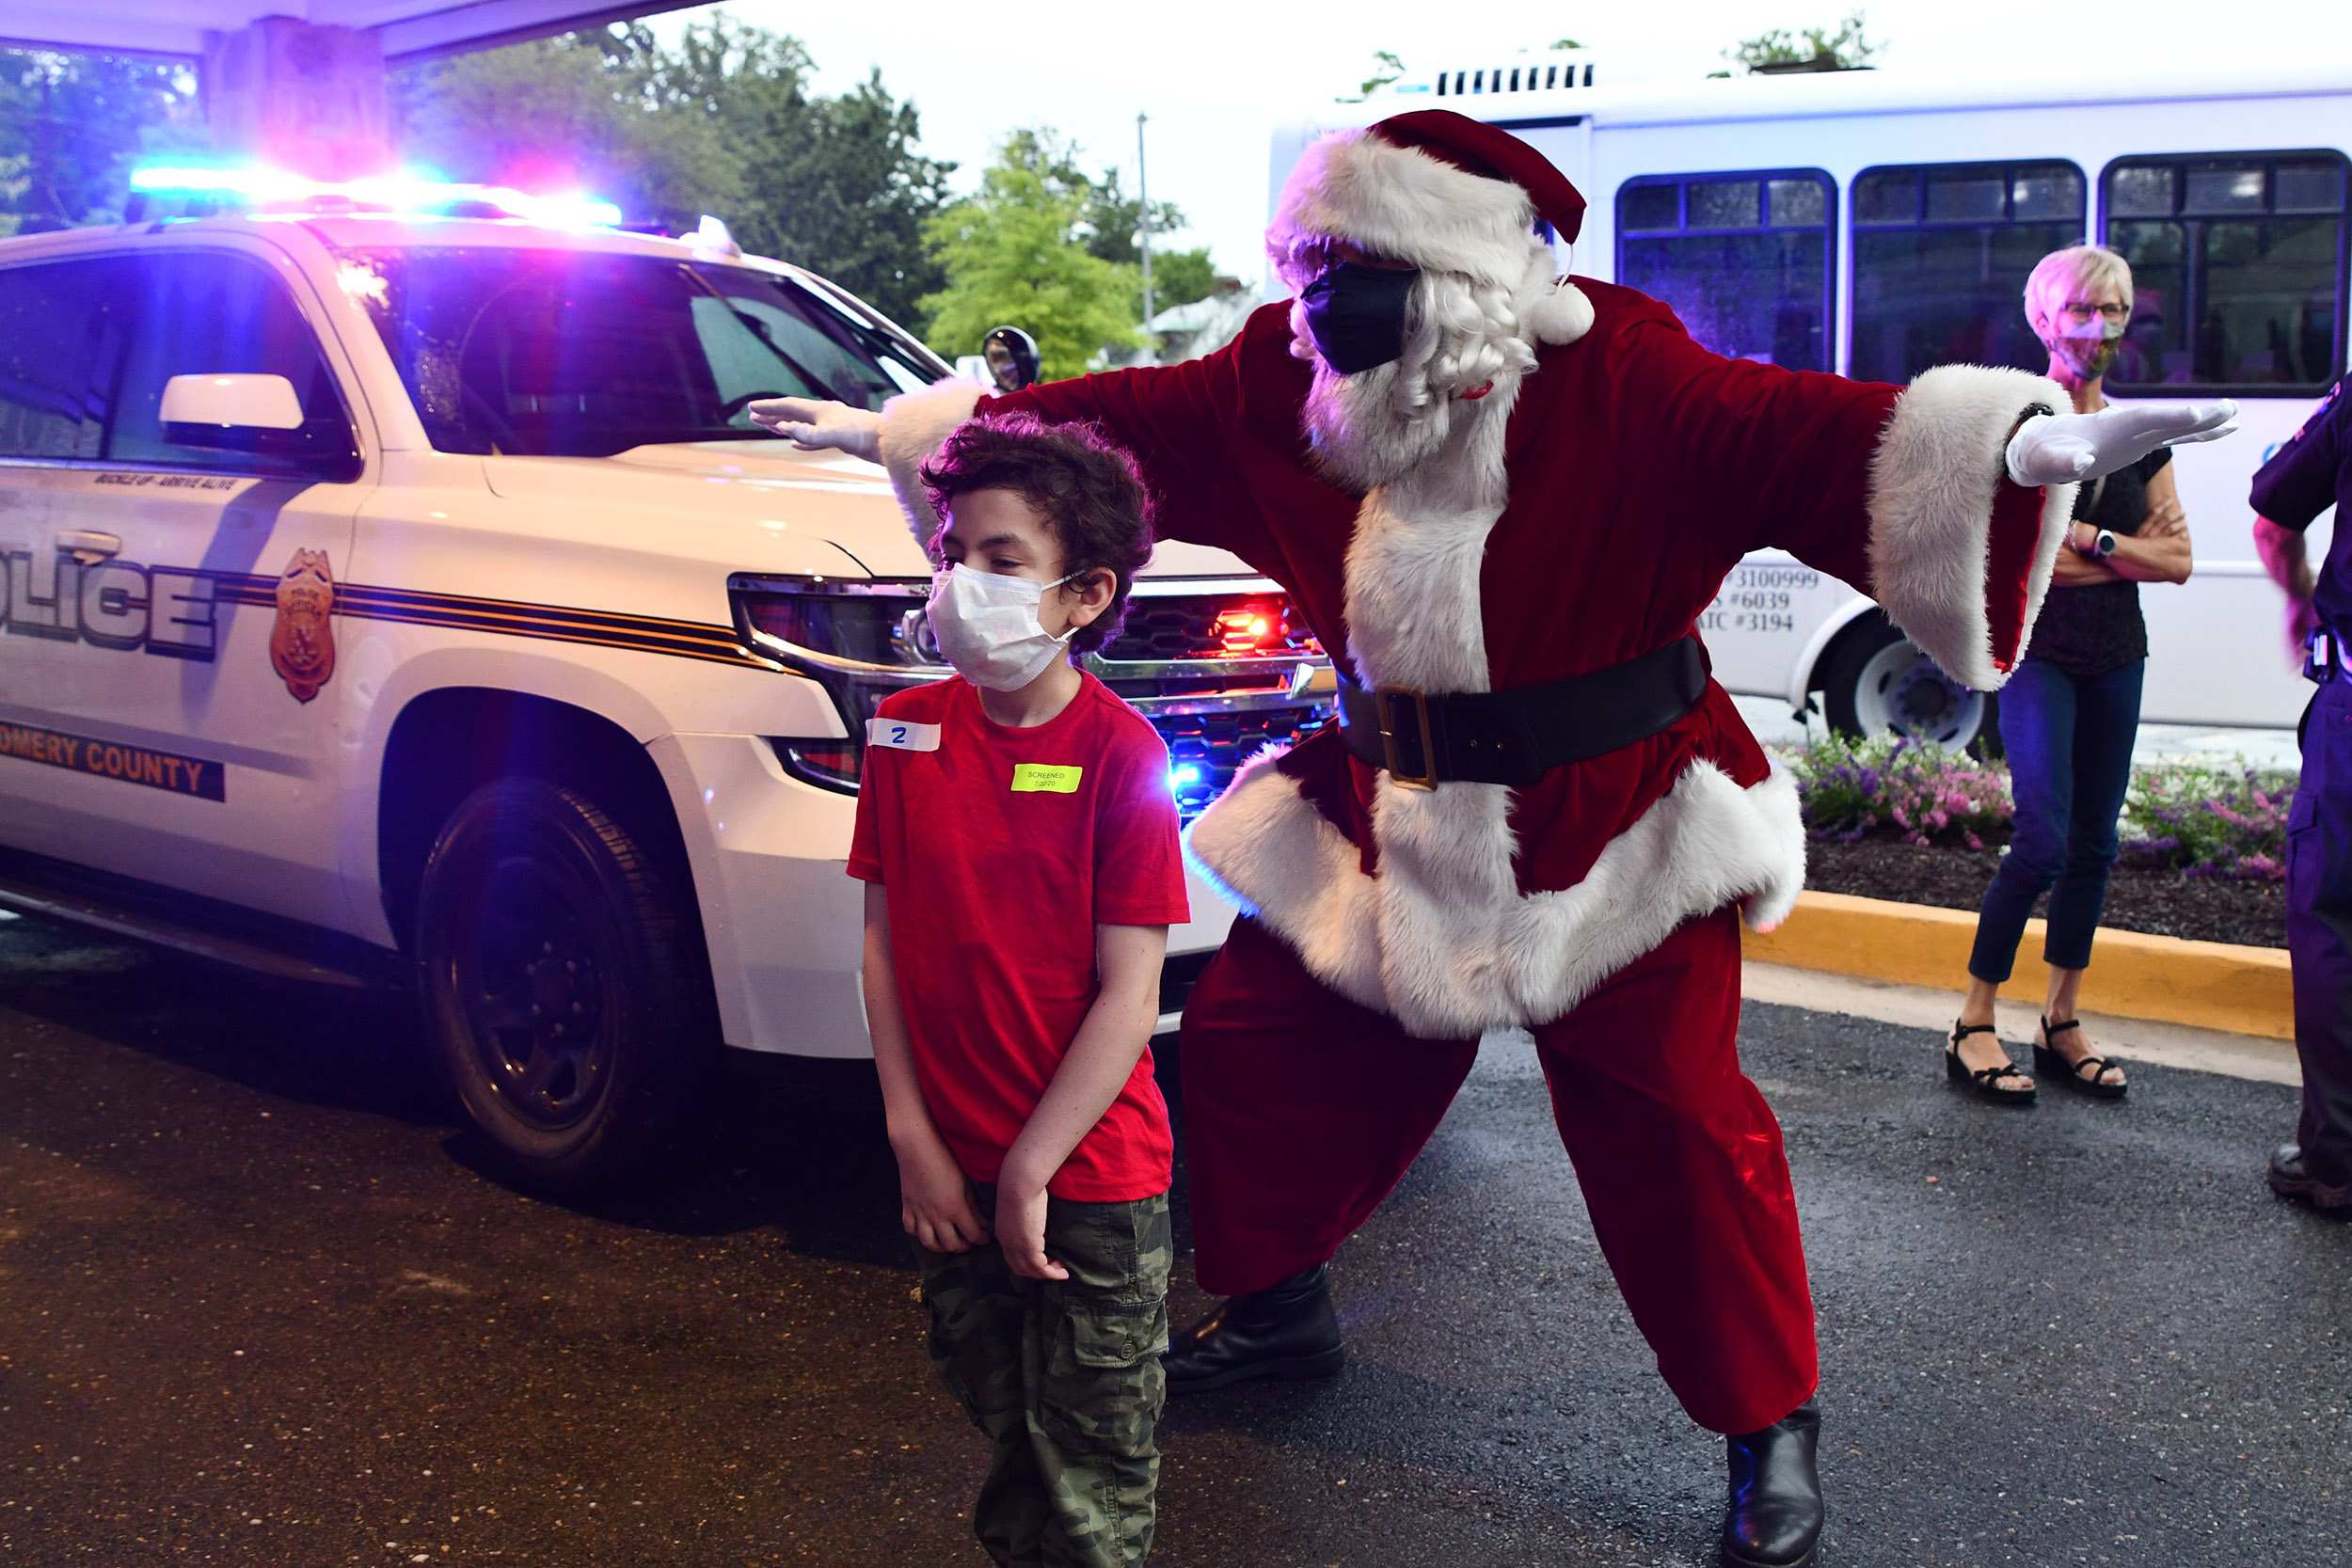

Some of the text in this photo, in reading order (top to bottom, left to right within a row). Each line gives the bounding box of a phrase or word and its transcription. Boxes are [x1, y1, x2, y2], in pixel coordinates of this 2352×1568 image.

[0, 549, 216, 663] LICE
[1730, 591, 1790, 609] #6039
[1736, 613, 1793, 631] #3194
[891, 726, 907, 744] 2
[86, 742, 203, 792] COUNTY
